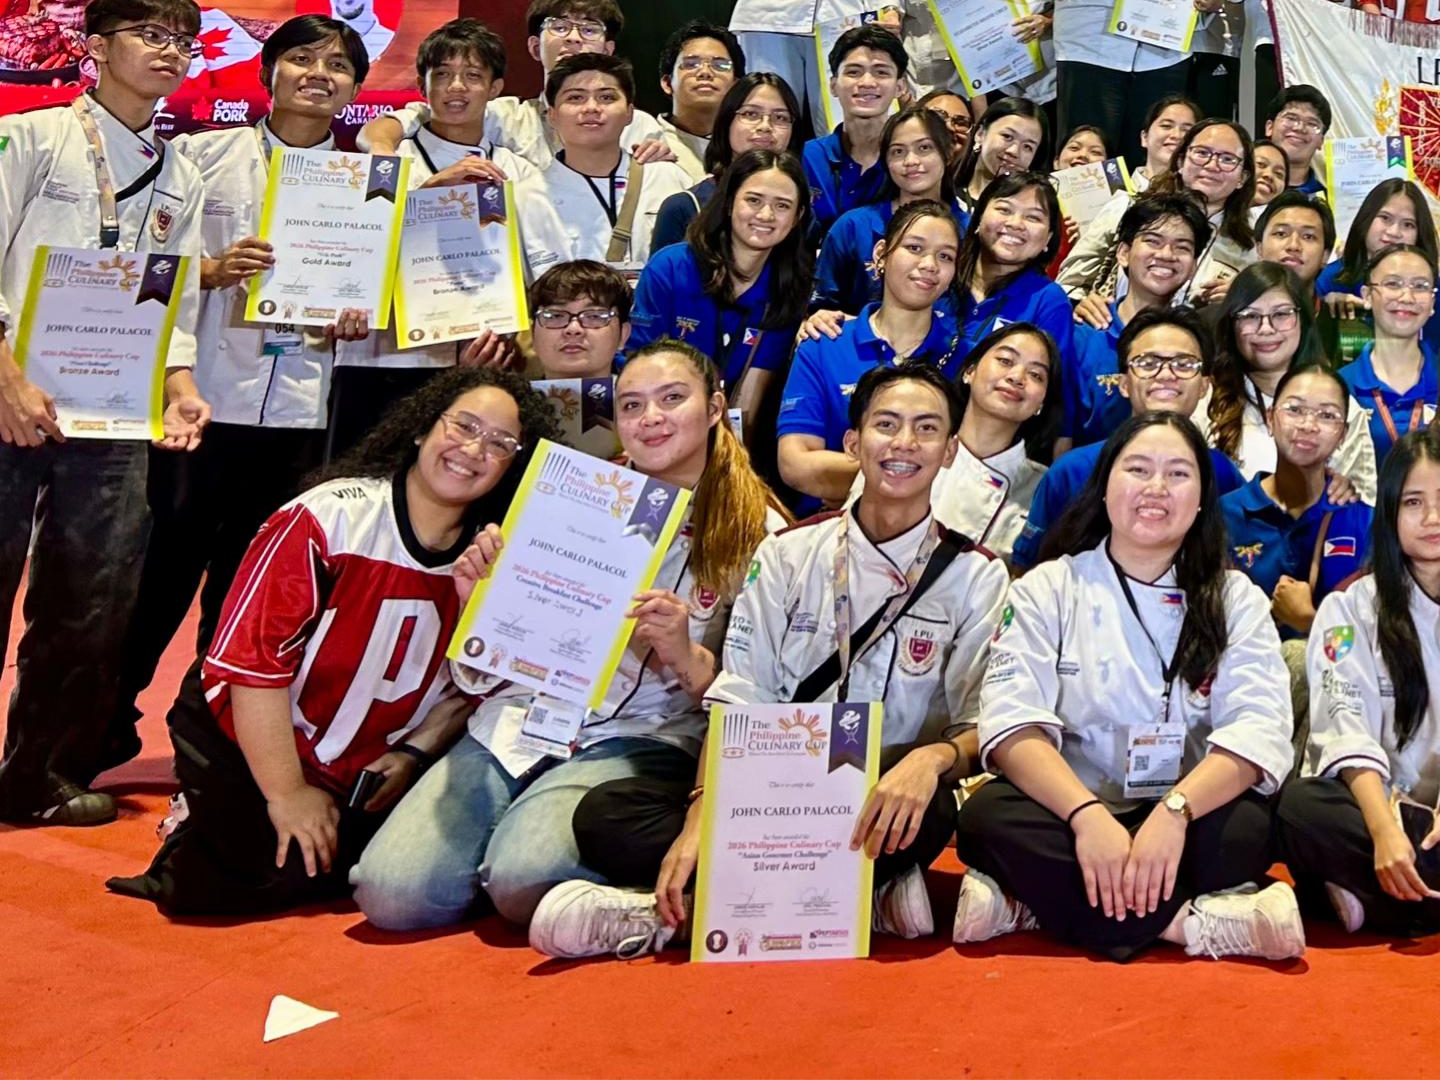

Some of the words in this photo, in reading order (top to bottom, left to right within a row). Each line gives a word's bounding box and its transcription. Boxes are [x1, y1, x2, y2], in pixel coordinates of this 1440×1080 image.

[214, 98, 249, 110] Canada
[213, 108, 248, 122] PORK
[301, 174, 347, 185] CULINARY
[284, 218, 312, 227] JOHN
[313, 220, 342, 229] CARLO
[302, 257, 322, 267] Gold
[325, 259, 351, 267] Award
[411, 256, 434, 265] JOHN
[436, 253, 464, 262] CARLO
[45, 323, 74, 334] JOHN
[75, 325, 108, 335] CARLO
[90, 366, 119, 376] Award
[570, 466, 588, 479] The
[332, 486, 368, 500] VIVA
[560, 484, 610, 508] CULINARY
[528, 537, 554, 555] JOHN
[555, 547, 586, 565] CARLO
[587, 555, 629, 578] PALACOL
[914, 630, 934, 638] LPU
[750, 719, 771, 729] The
[749, 730, 800, 742] Philippine
[748, 741, 800, 751] CULINARY
[804, 741, 827, 751] CUP
[731, 807, 761, 819] JOHN
[764, 806, 801, 817] CARLO
[803, 805, 853, 816] PALACOL
[728, 841, 747, 850] 2026
[748, 841, 789, 851] Philippine
[790, 840, 824, 849] Culinary
[825, 840, 841, 850] Cup
[753, 861, 780, 872] Silver
[782, 861, 816, 872] Award
